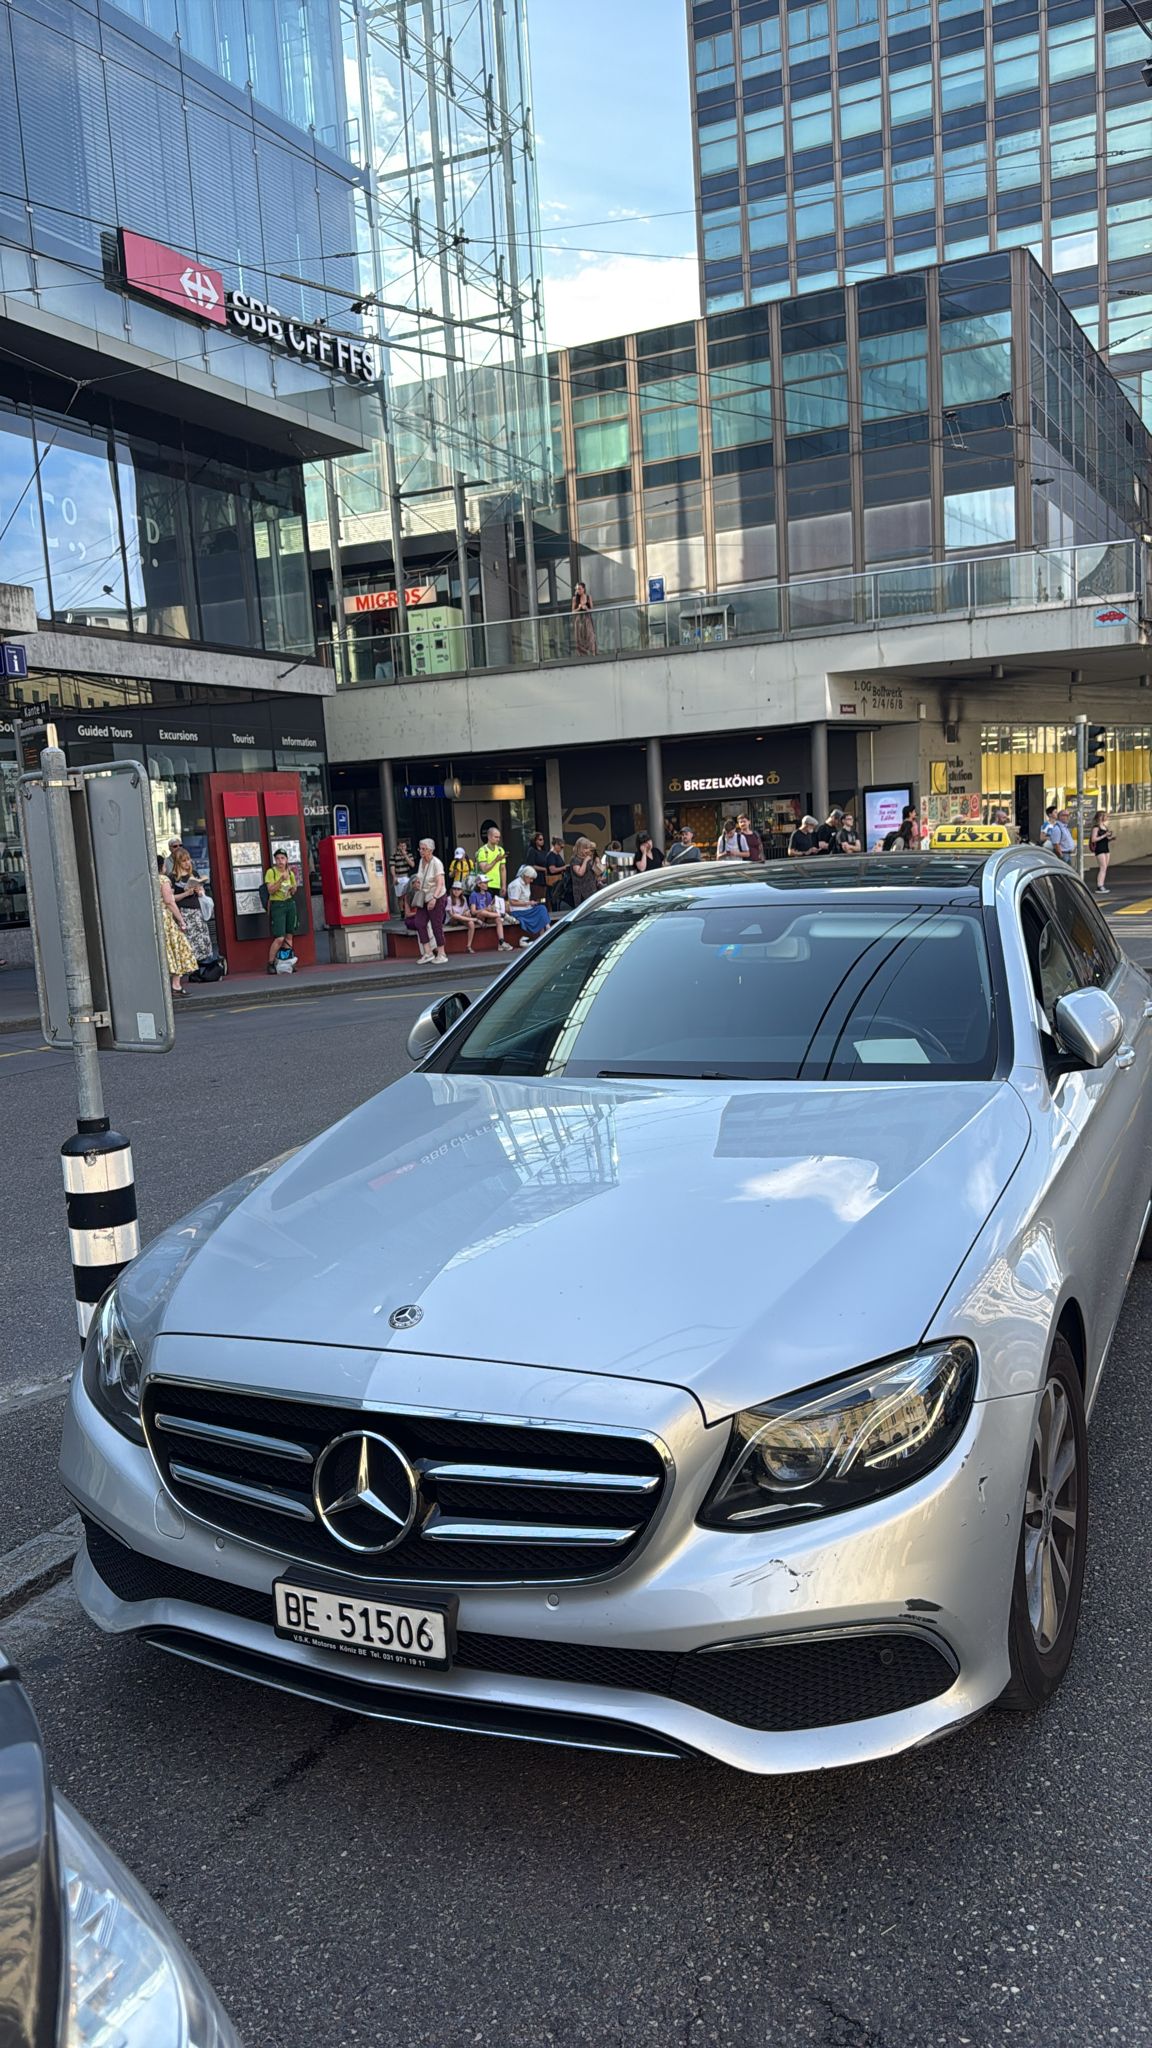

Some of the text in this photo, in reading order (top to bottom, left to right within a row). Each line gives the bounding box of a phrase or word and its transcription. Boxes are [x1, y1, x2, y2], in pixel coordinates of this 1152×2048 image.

[232, 290, 376, 383] SBB CFF FFS
[24, 704, 40, 718] Kante
[872, 698, 903, 710] 2/4/6/8
[78, 725, 134, 739] Guided Tours
[159, 728, 199, 743] Excursions
[232, 733, 255, 745] Tourist
[281, 735, 318, 748] Information
[684, 774, 764, 791] BREZELKÖNIG
[941, 832, 1000, 842] TAXI
[337, 842, 362, 850] Tickets
[339, 1644, 357, 1654] Köniz
[370, 1650, 381, 1659] Tel.
[395, 1656, 407, 1664] 971
